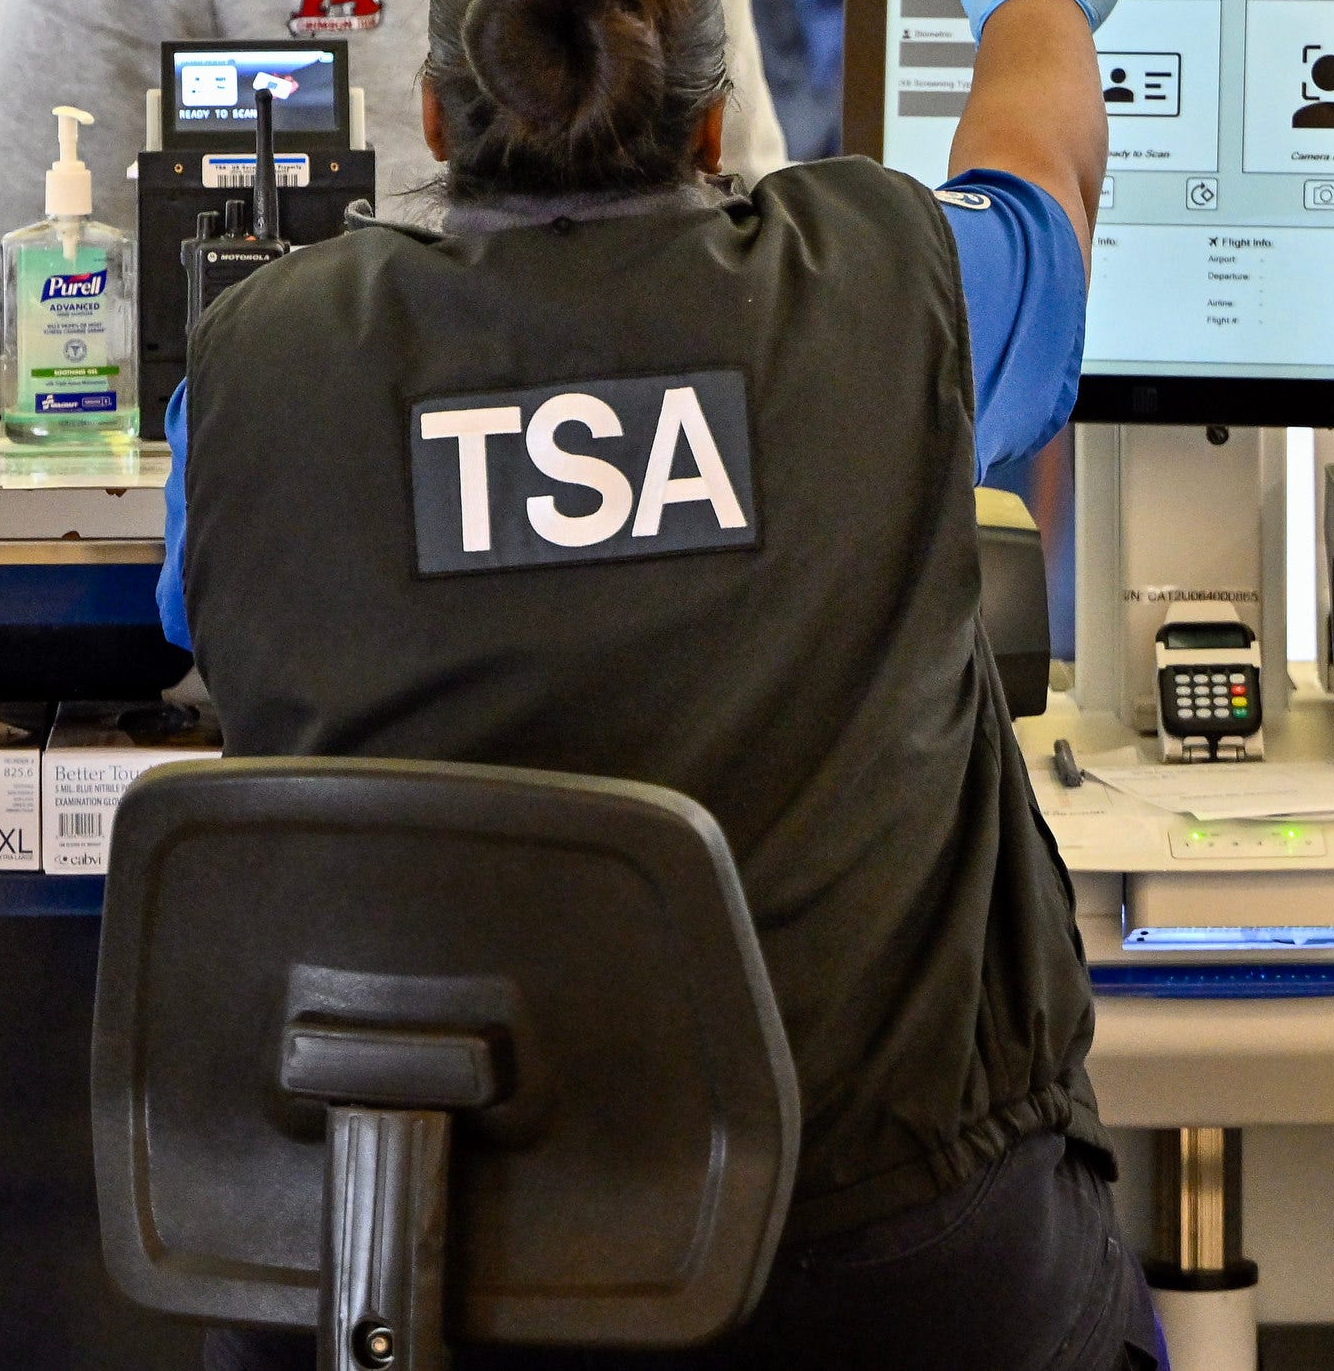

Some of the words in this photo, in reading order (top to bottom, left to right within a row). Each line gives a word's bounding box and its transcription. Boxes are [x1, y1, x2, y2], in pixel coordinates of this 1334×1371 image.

[957, 80, 972, 89] Typ
[179, 109, 210, 120] READY
[215, 109, 228, 119] TO
[232, 108, 258, 120] SCAN
[1107, 150, 1130, 159] eady
[1133, 150, 1142, 158] to
[1145, 149, 1170, 158] Scan
[1291, 151, 1329, 161] Camera
[1222, 237, 1250, 249] Flight
[50, 302, 100, 311] ADVANCED
[1207, 316, 1230, 325] Flight
[420, 387, 747, 553] TSA
[4, 768, 33, 777] 825.6
[55, 765, 105, 781] Better
[109, 765, 140, 781] Tou
[76, 784, 92, 793] BLUE
[95, 784, 119, 793] NITRILE
[55, 797, 101, 806] EXAMINATION
[104, 797, 124, 806] GLOV
[71, 852, 101, 865] cabvi
